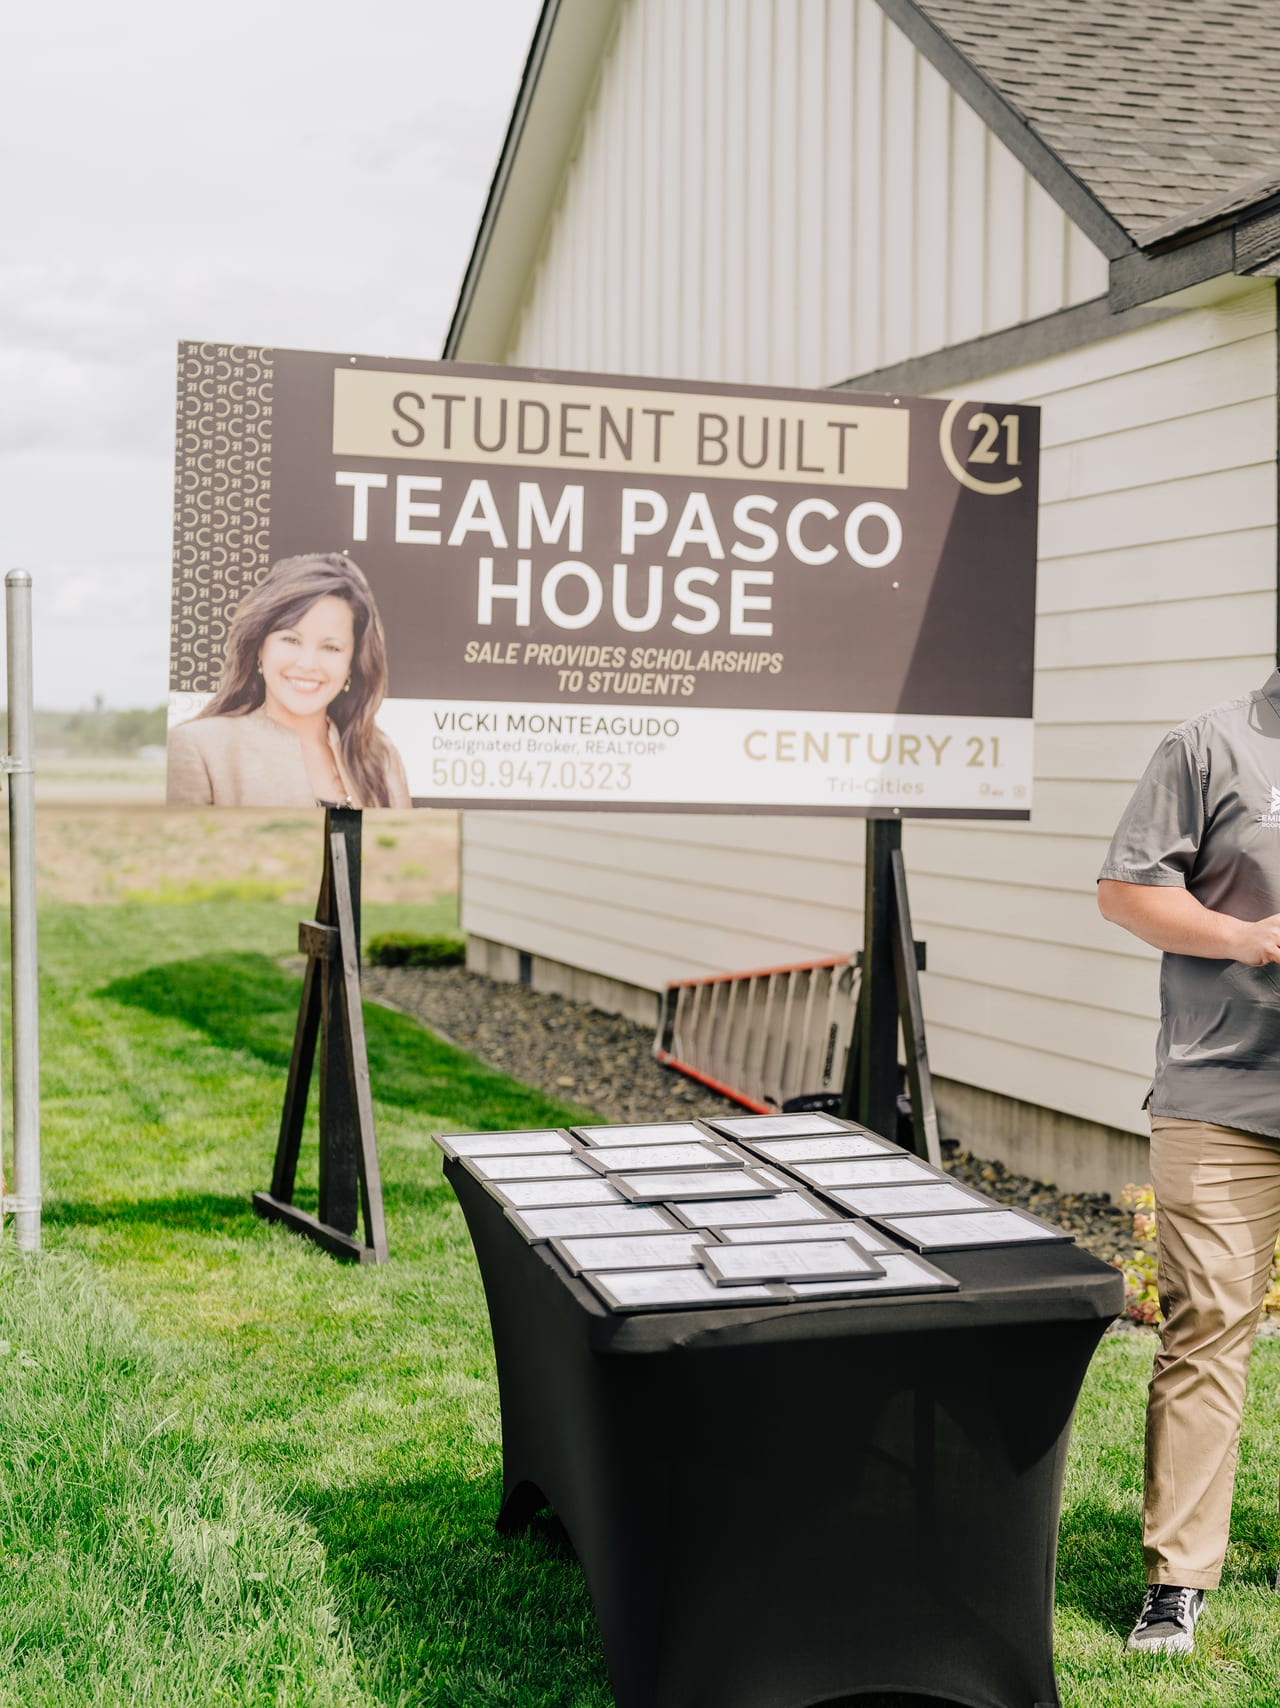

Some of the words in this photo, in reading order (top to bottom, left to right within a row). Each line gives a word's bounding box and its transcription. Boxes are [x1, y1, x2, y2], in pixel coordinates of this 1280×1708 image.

[391, 391, 675, 463] STUDENT
[697, 411, 858, 474] BUILT
[335, 471, 585, 552] TEAM
[620, 488, 903, 568] PASCO
[477, 557, 774, 636] HOUSE
[464, 641, 521, 665] SALE
[523, 644, 626, 668] PROVIDES
[629, 648, 784, 674] SCHOLARSHIPS
[557, 670, 584, 692] TO
[586, 672, 696, 696] STUDENTS
[434, 712, 497, 732] VICKI
[507, 714, 680, 737] MONTEAGUDO
[432, 736, 521, 755] Designated
[527, 739, 580, 756] Broker,
[743, 730, 952, 766] CENTURY
[431, 757, 633, 790] 509.947.0323
[826, 776, 925, 795] Tri-Cities
